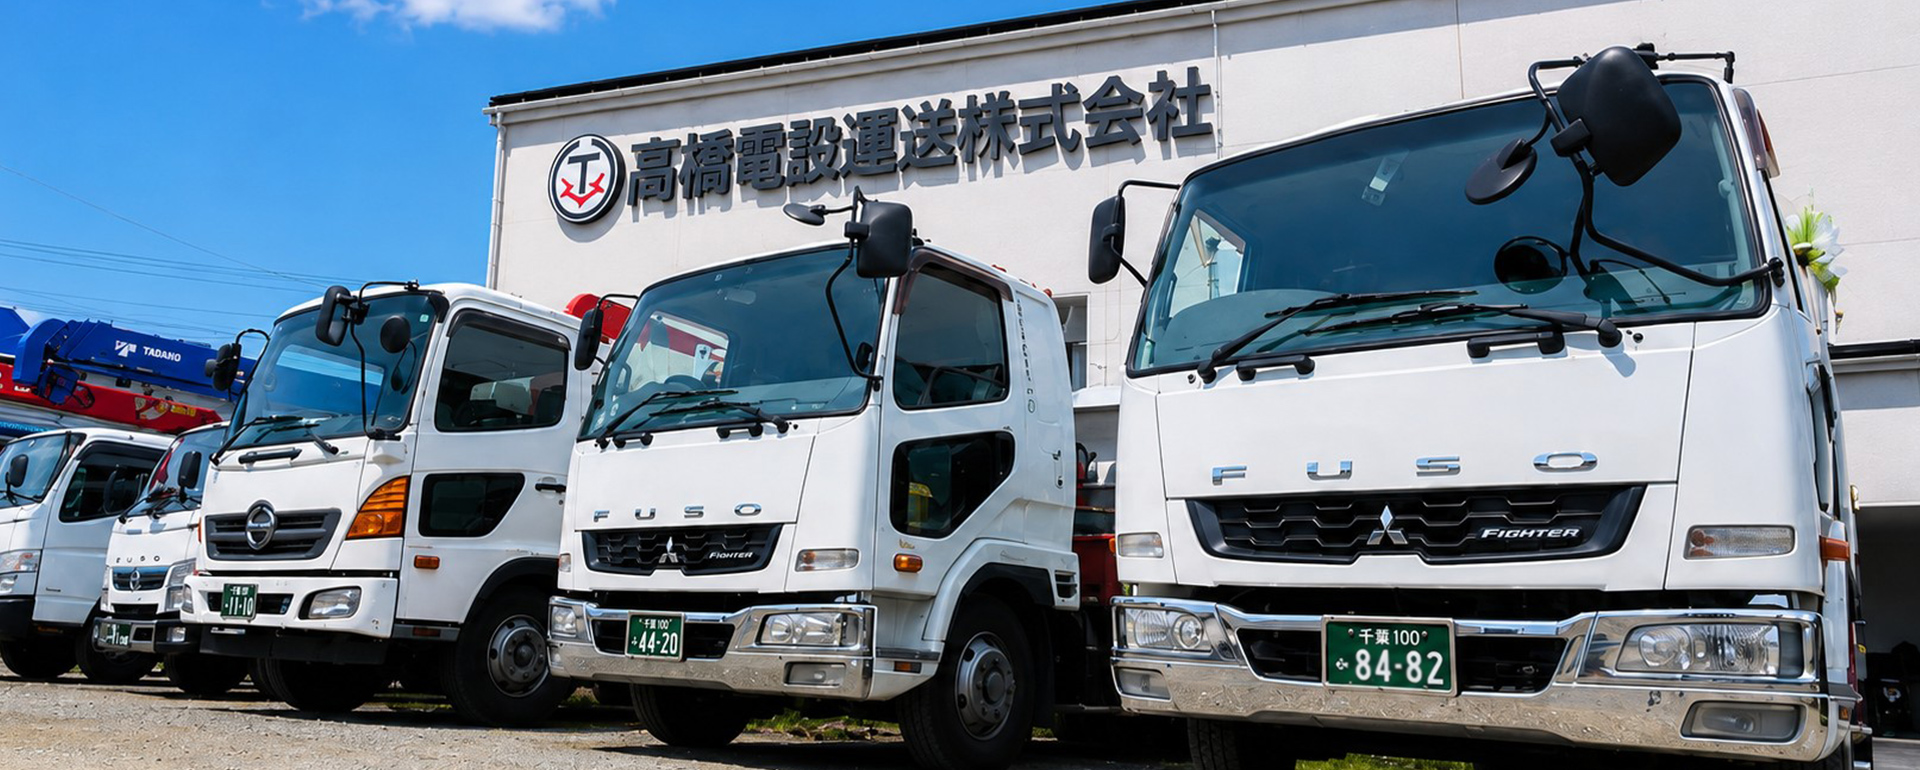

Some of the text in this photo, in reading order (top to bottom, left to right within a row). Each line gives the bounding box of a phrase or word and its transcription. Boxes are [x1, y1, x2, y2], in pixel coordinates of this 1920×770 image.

[627, 66, 1213, 206] 高橋電設運送株式会社
[142, 345, 182, 363] TADANO
[1212, 452, 1598, 486] FUSO
[593, 503, 762, 523] FUSO
[1481, 528, 1580, 539] FIGHTER
[116, 555, 161, 564] FUSO
[708, 551, 754, 559] FIGHTER
[657, 619, 670, 630] 100
[638, 630, 679, 655] 44-20
[1358, 628, 1420, 646] 千葉 100
[1355, 648, 1445, 686] 84-82
